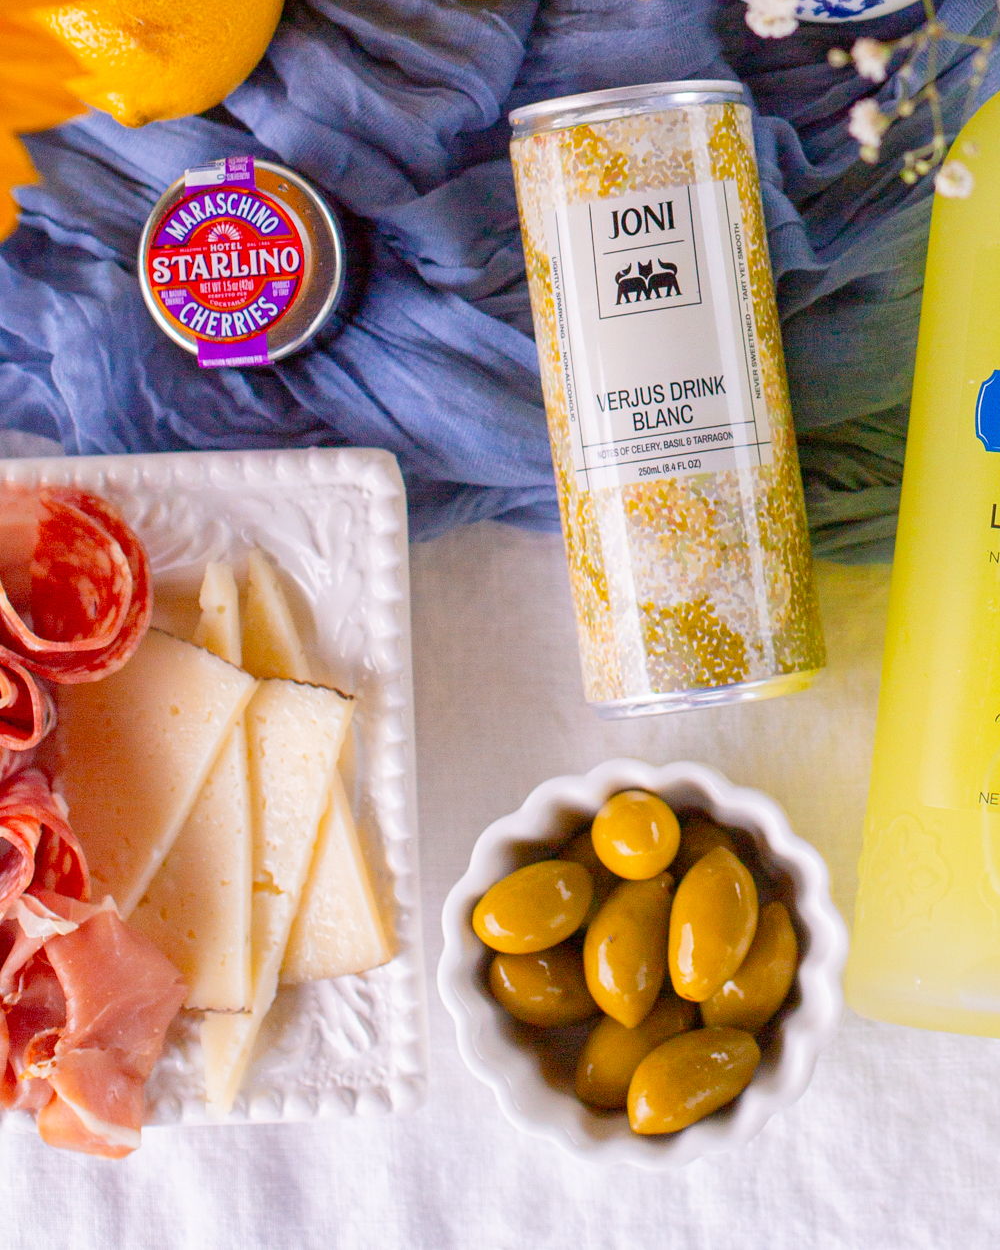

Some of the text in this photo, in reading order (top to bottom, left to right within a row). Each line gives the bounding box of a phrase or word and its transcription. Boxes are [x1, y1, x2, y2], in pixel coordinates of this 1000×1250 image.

[165, 193, 279, 242] MARASCHINO
[608, 200, 677, 240] JONI
[210, 242, 243, 252] HOTEL
[734, 222, 744, 260] SMOOTH
[152, 247, 300, 284] STARLINO
[200, 282, 211, 294] NET
[212, 281, 223, 293] WT
[179, 296, 279, 337] CHERRIES
[555, 291, 566, 340] SPARKLING
[563, 351, 576, 423] NON-ALCOHOLIC
[745, 313, 758, 368] SWEETENED
[597, 375, 726, 413] VERJUS DRINK
[751, 369, 762, 399] NEVER
[632, 404, 694, 432] BLANC
[619, 446, 630, 457] OF
[631, 442, 662, 455] CELERY,
[663, 438, 684, 449] BASIL
[693, 430, 734, 445] TARRAGON
[638, 458, 702, 477] 250mL (8.4 FL OZ)
